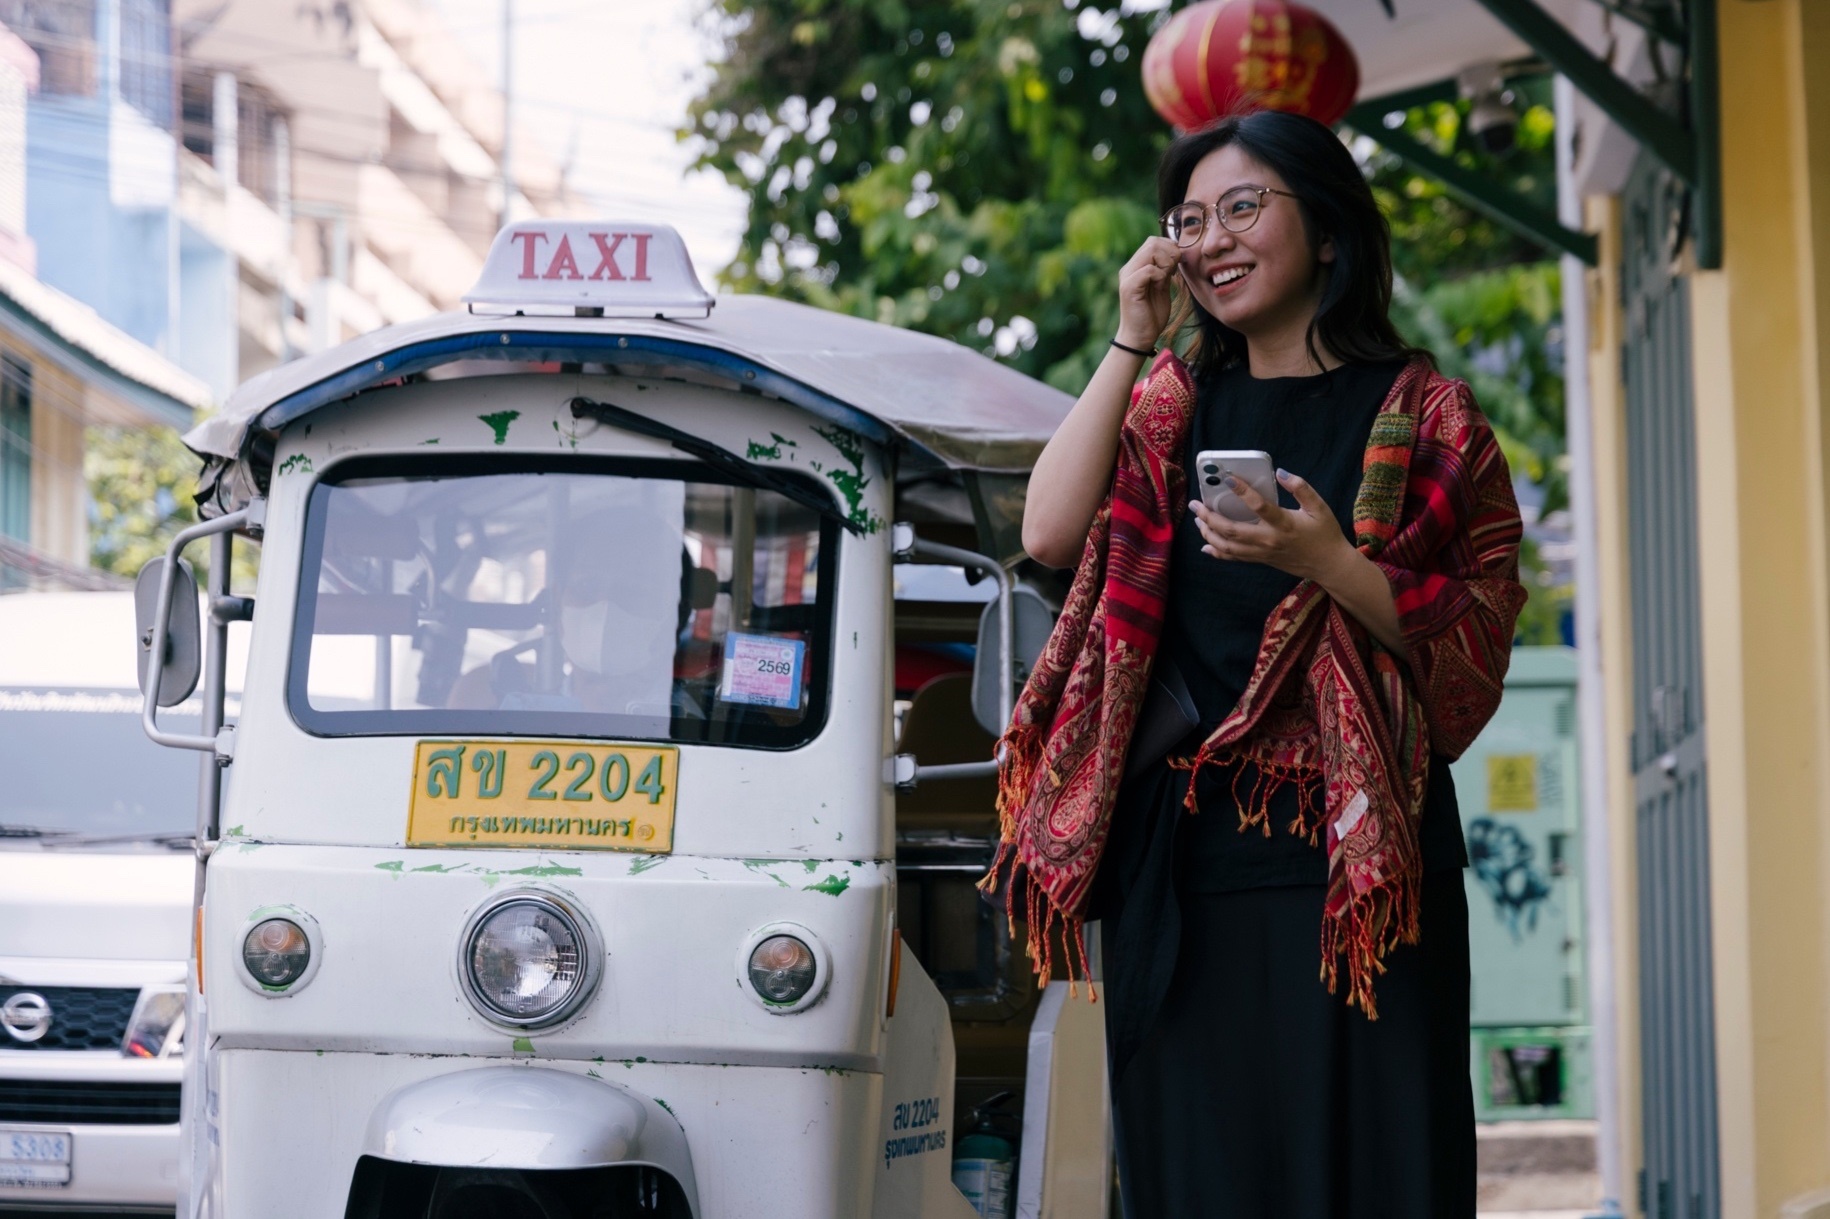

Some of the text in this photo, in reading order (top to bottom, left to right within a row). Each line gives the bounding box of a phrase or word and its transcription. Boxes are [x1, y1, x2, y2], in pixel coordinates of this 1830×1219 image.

[511, 232, 653, 281] TAXI
[758, 659, 790, 675] 2569
[427, 745, 665, 804] สข 2204
[449, 815, 632, 840] กรุงเทพมหานคร
[911, 1097, 940, 1128] 2204
